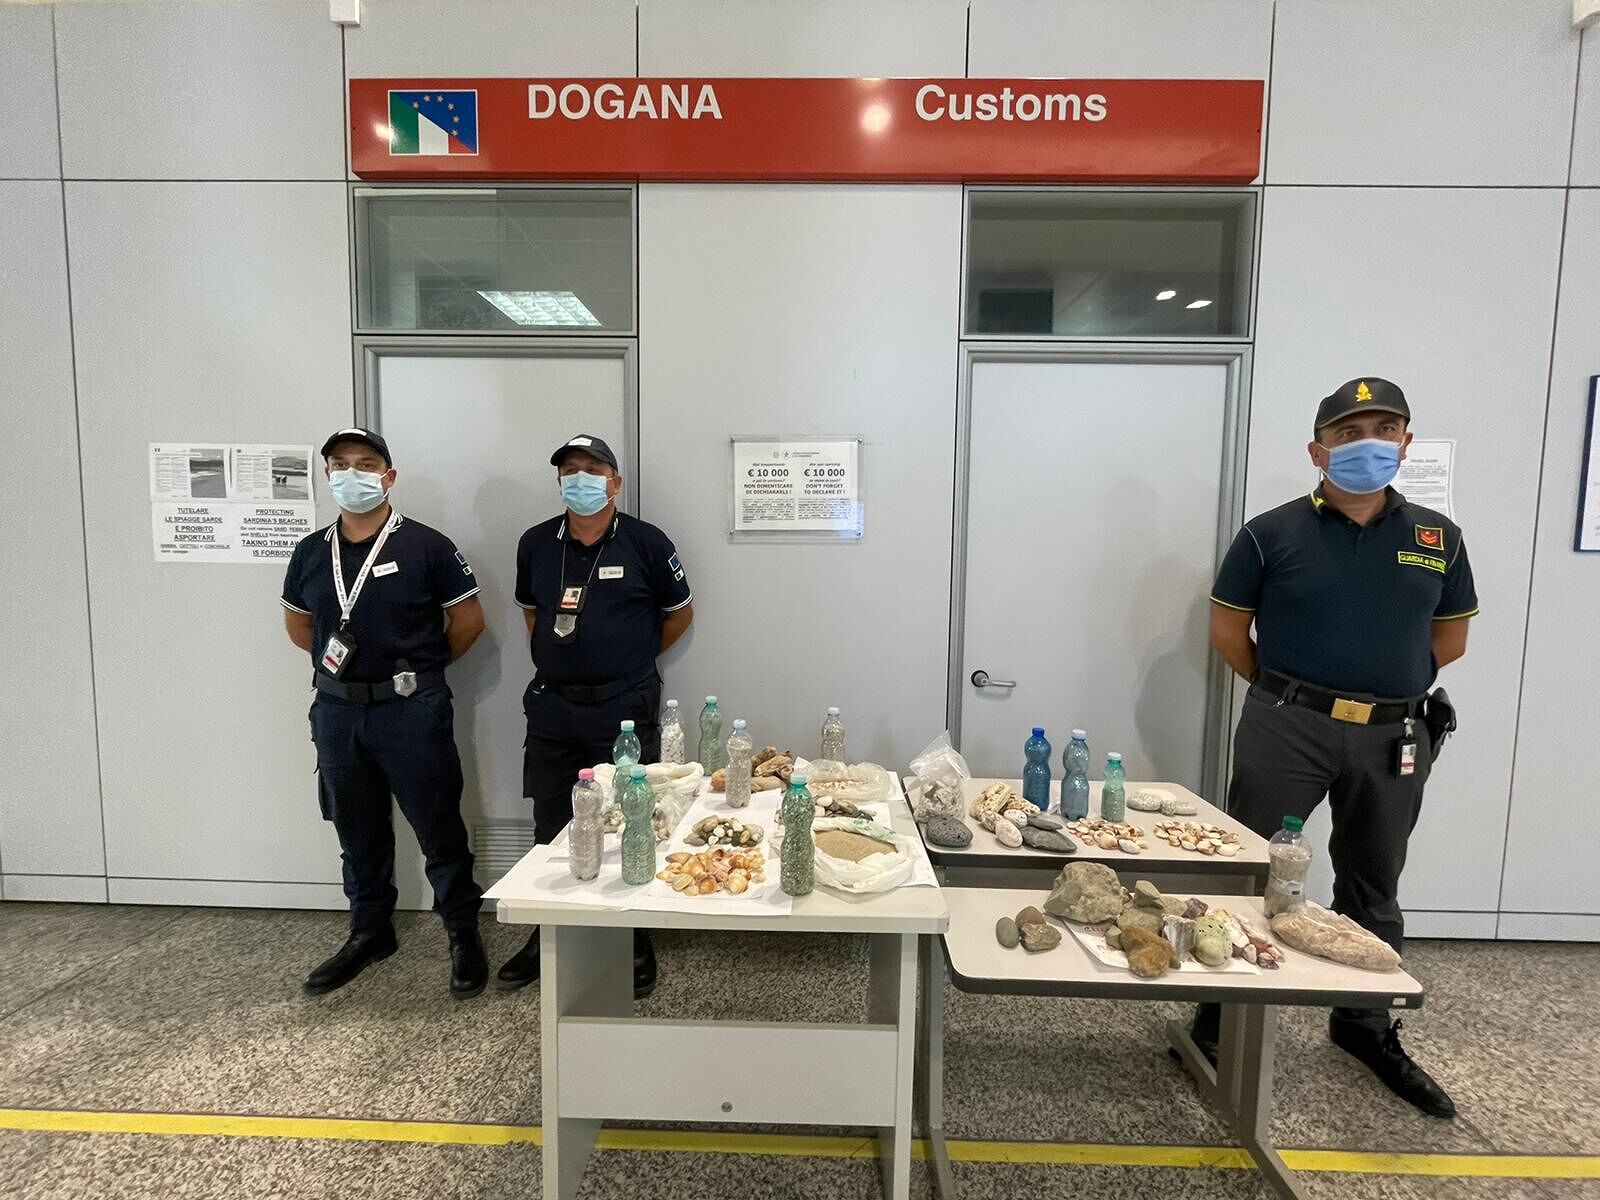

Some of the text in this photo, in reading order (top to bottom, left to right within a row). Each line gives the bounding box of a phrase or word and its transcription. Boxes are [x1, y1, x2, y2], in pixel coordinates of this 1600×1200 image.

[528, 83, 723, 120] DOGANA
[915, 84, 1107, 121] Customs
[748, 469, 789, 477] € 10 000
[804, 469, 845, 477] € 10 000
